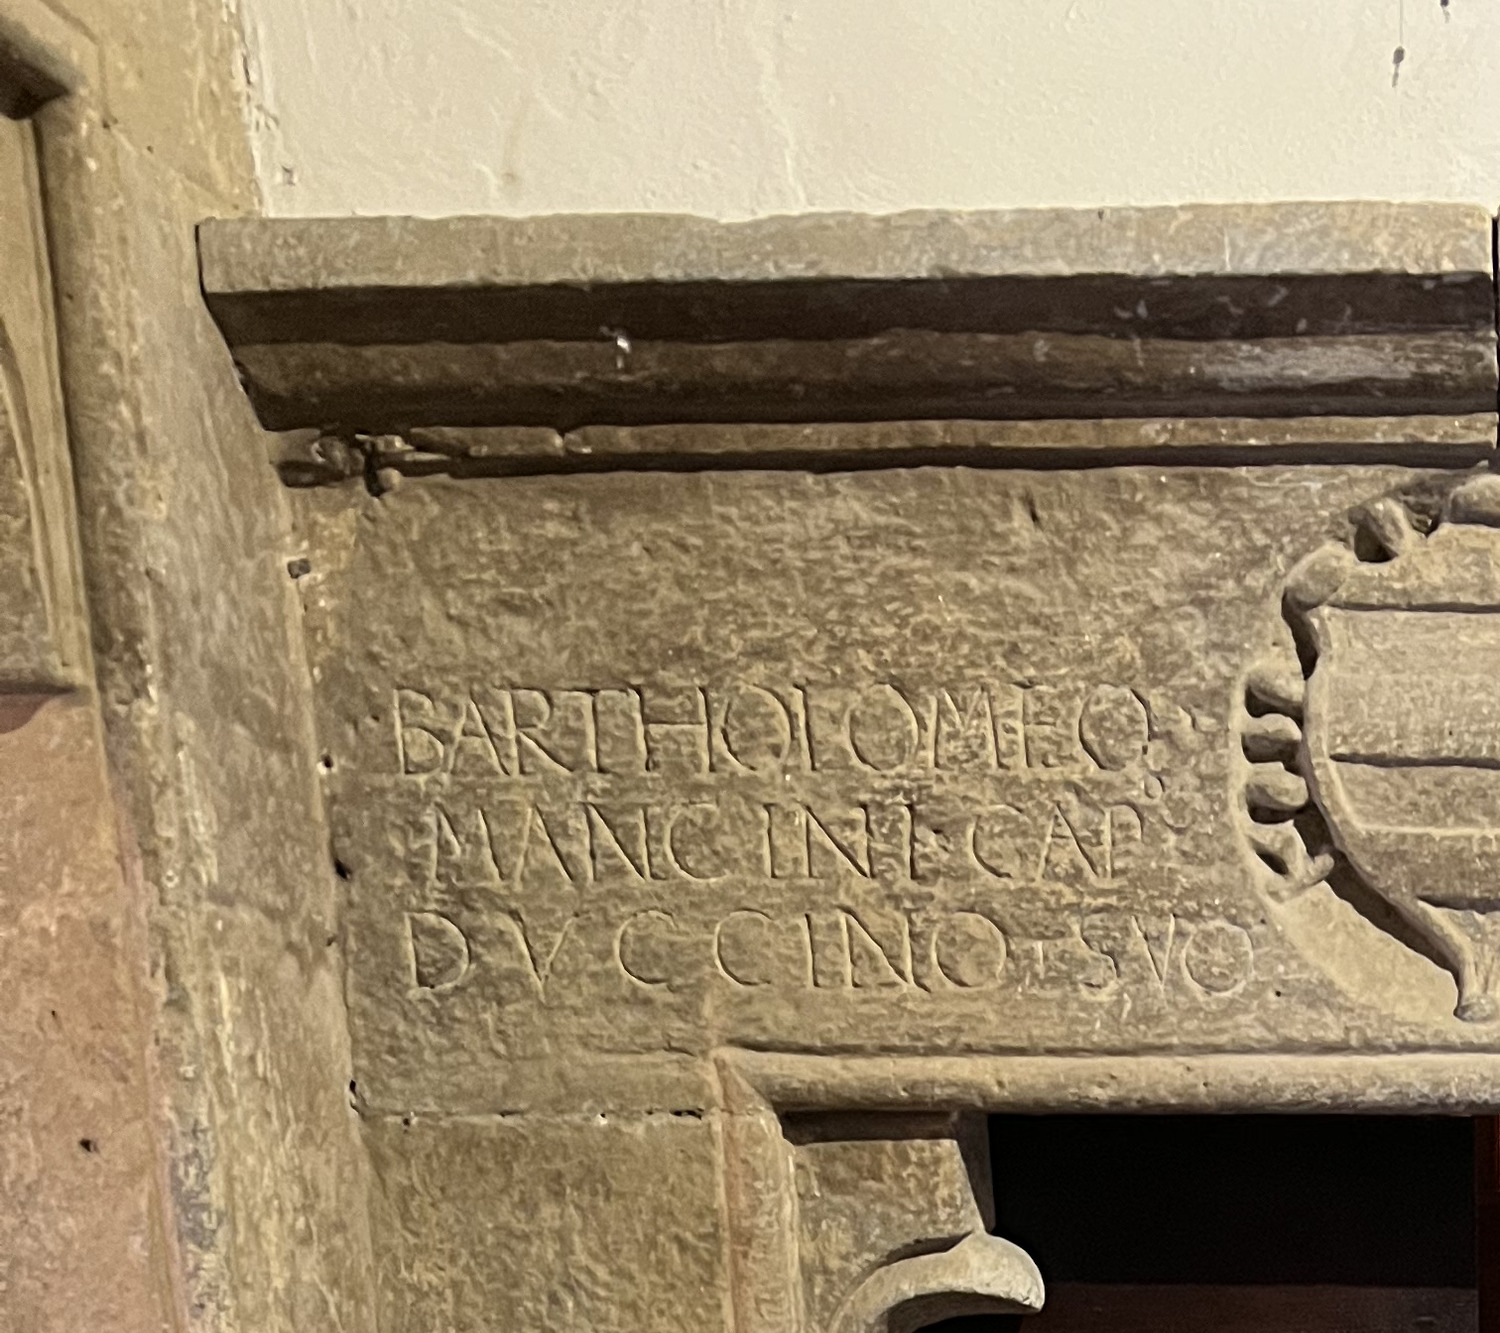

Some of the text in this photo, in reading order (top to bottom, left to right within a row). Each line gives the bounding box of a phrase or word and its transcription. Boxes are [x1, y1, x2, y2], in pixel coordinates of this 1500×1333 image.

[393, 683, 1151, 777] BARTHOLOMEO
[428, 798, 924, 883] MANCINI
[402, 905, 1008, 1003] DVCCINO
